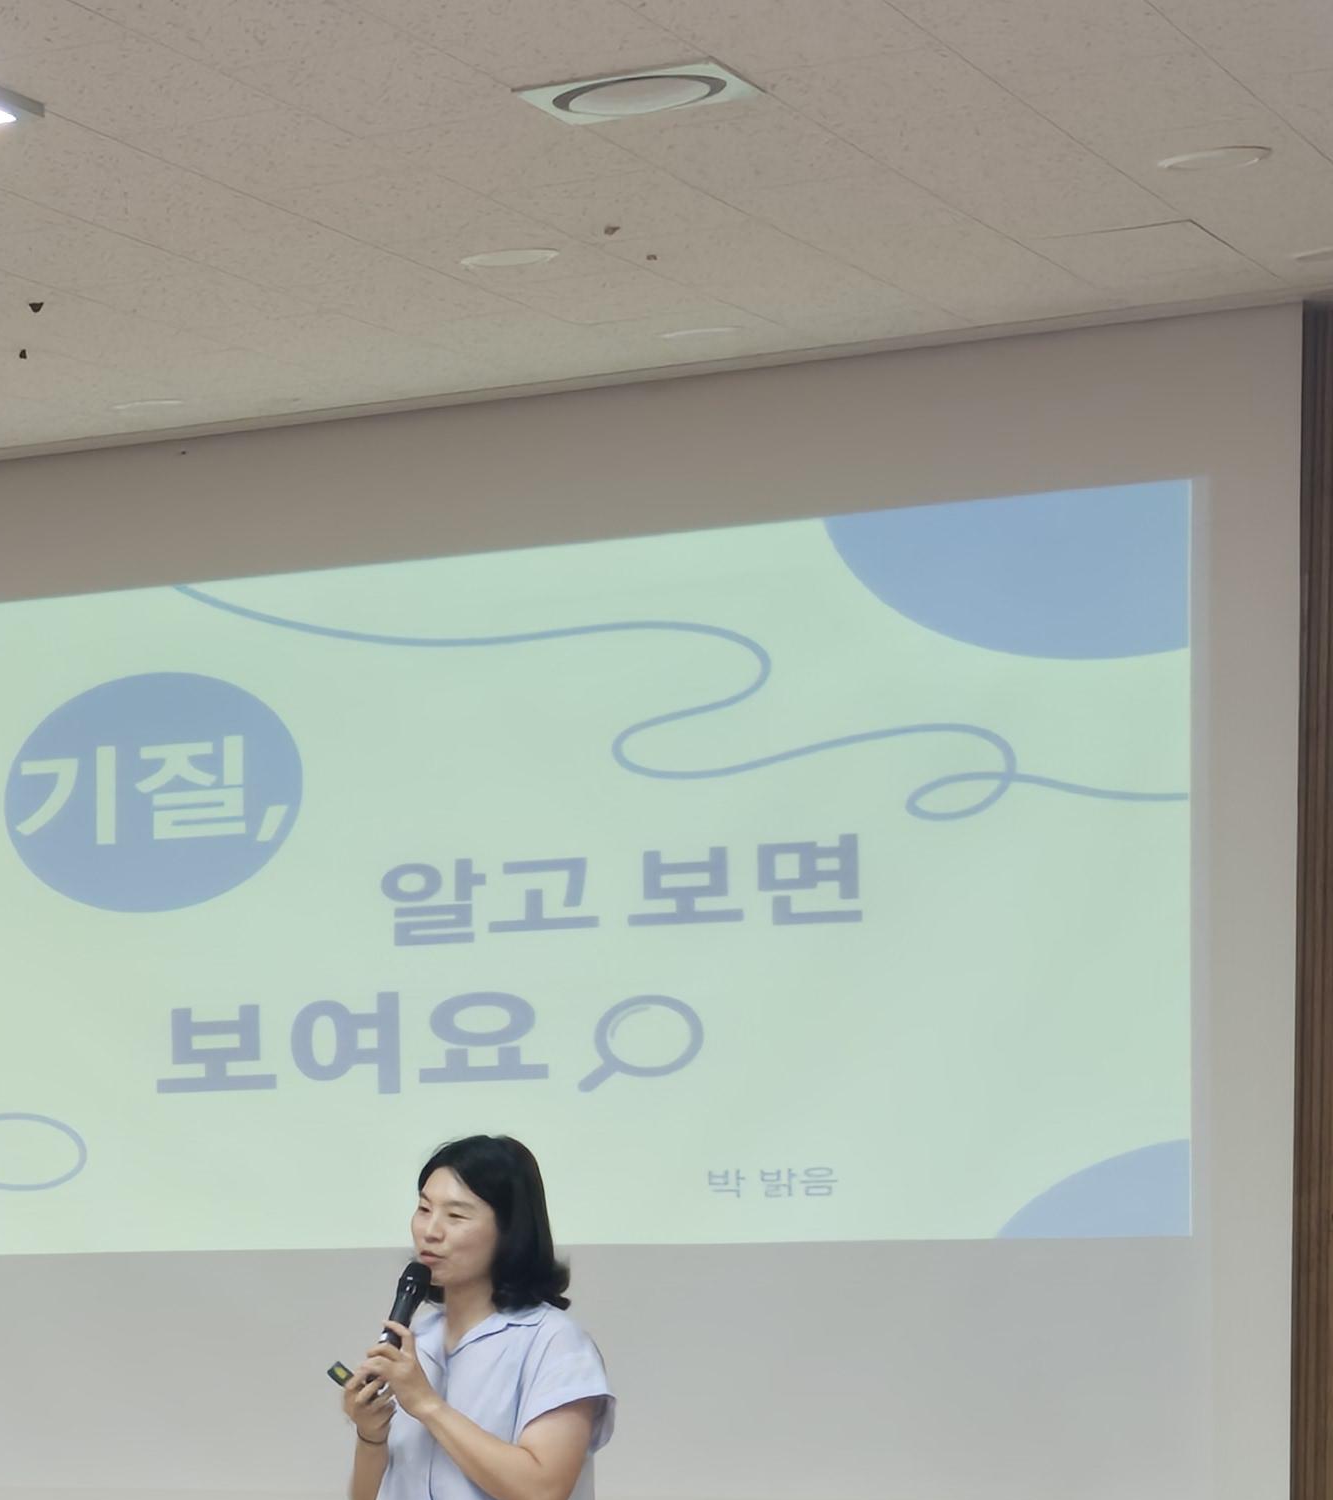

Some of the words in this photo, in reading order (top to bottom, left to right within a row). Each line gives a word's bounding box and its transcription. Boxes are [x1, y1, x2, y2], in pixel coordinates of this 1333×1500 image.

[15, 735, 289, 845] 기질,
[380, 857, 600, 947] 알고
[627, 833, 864, 927] 보면
[156, 991, 550, 1094] 보여요
[707, 1168, 746, 1199] 박
[759, 1166, 839, 1199] 밝음
